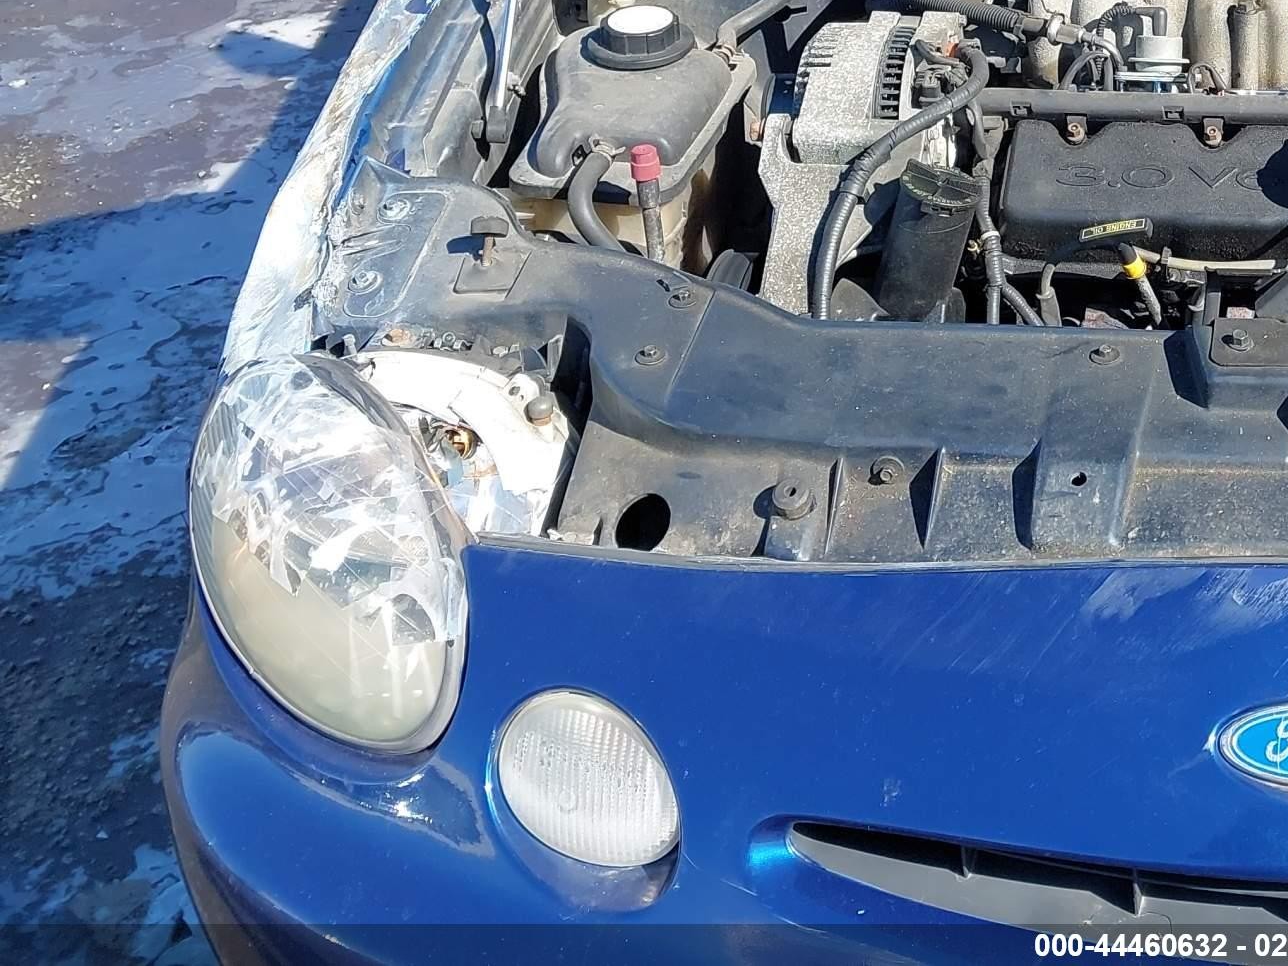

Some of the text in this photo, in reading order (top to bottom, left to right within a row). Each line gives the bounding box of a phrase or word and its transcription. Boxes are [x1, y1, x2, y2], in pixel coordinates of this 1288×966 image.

[1055, 163, 1175, 189] 3.0
[1092, 220, 1137, 236] ENGINE OIL
